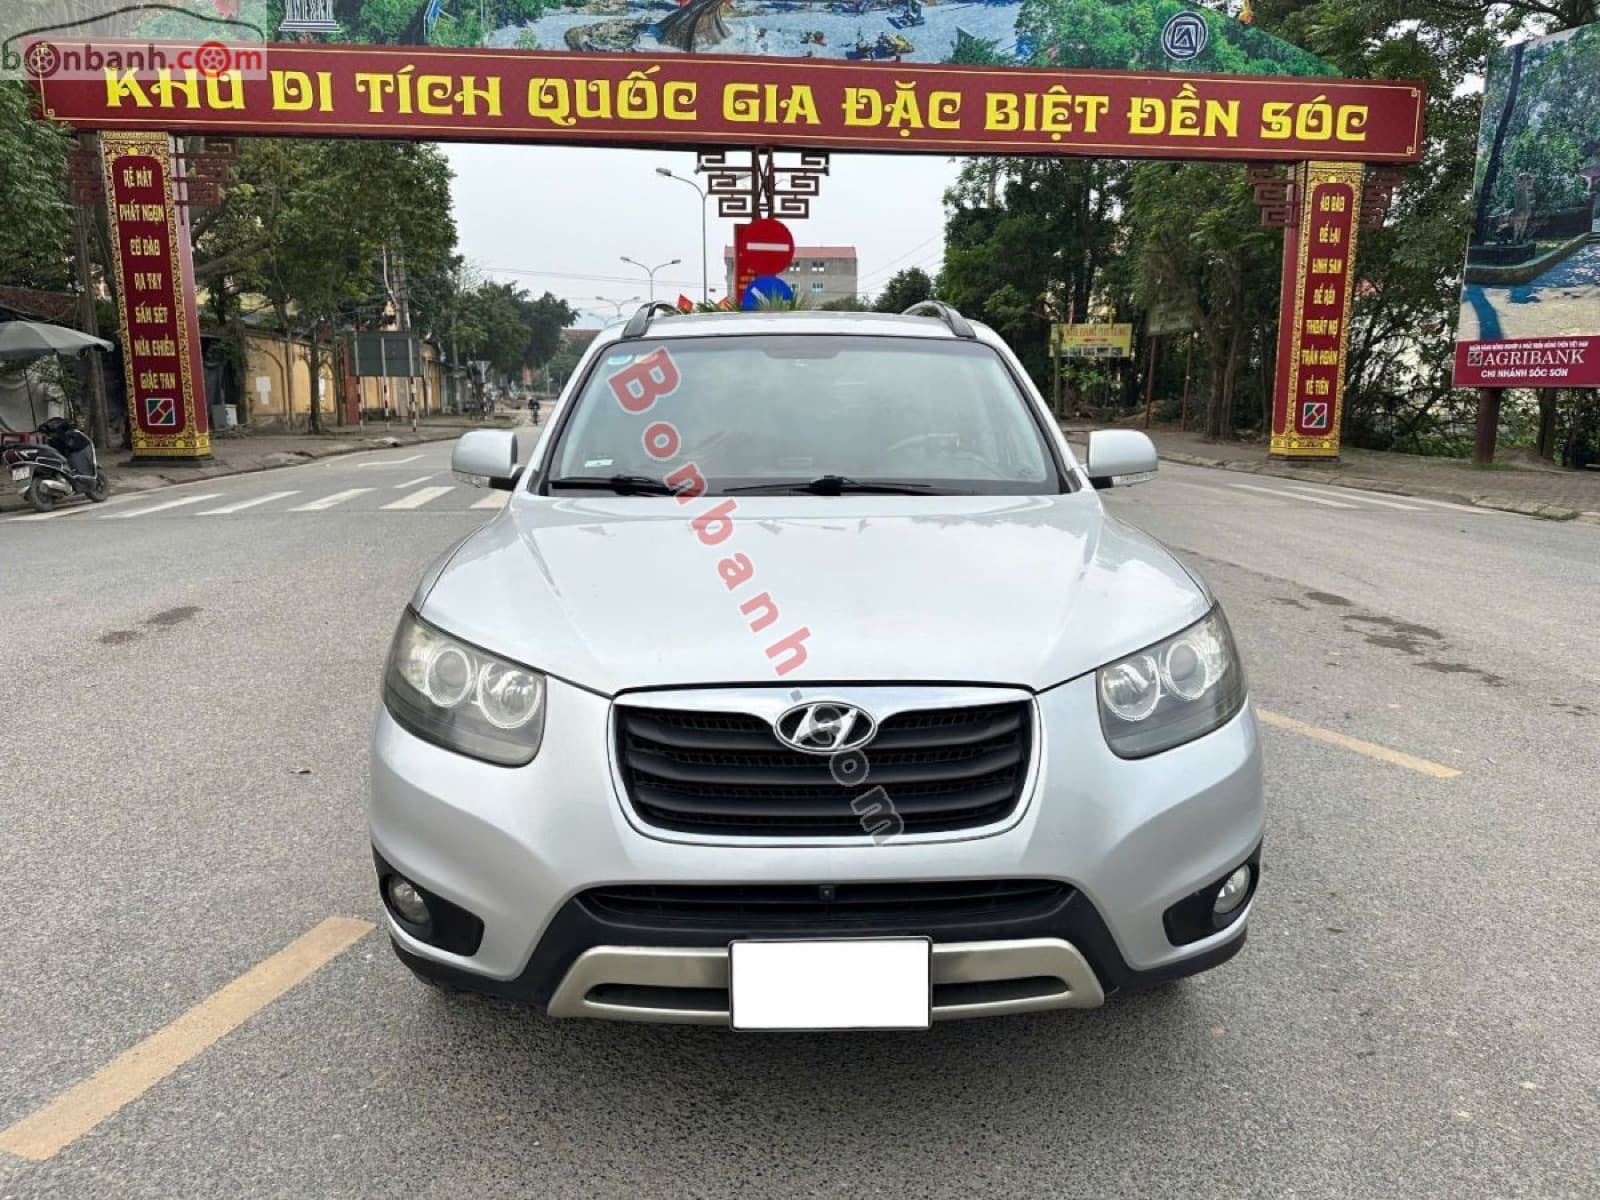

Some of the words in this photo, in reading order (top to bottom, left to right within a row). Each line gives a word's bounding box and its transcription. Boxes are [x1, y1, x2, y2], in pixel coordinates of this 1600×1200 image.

[105, 66, 245, 110] KHU
[271, 72, 332, 112] DI
[355, 65, 502, 117] TÍCH
[527, 66, 698, 126] QUỐC
[722, 84, 820, 124] GIA
[843, 80, 961, 137] ĐẶC
[985, 87, 1109, 142] BIỆT
[1127, 83, 1239, 137] ĐỀN
[1260, 95, 1368, 141] SÓC
[1484, 349, 1585, 366] AGRIBANK
[1481, 369, 1496, 378] CHI
[1498, 367, 1527, 378] NHÁNH
[1529, 367, 1547, 377] SÓC
[1549, 367, 1568, 377] SƠN
